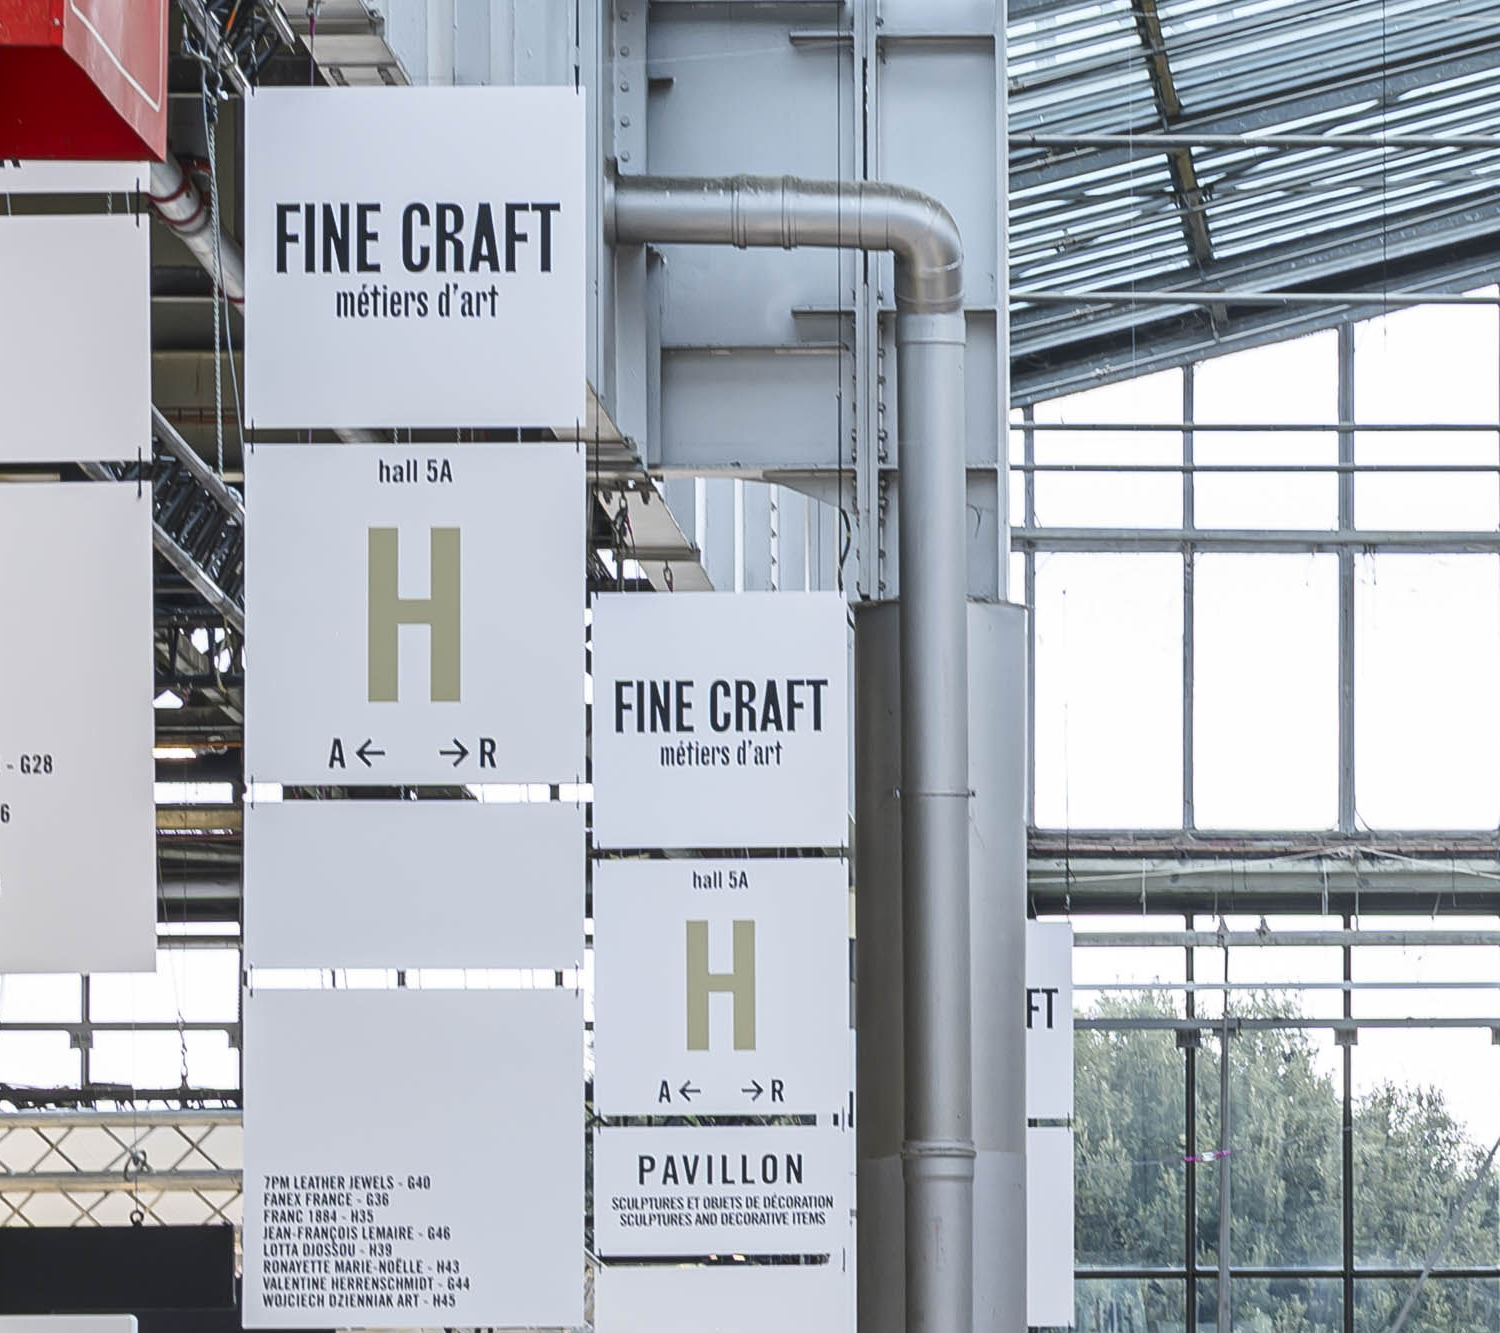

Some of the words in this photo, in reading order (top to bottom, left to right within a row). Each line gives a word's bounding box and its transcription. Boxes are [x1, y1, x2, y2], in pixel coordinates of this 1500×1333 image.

[276, 203, 381, 273] FINE
[402, 203, 560, 272] CRAFT
[337, 284, 428, 317] métiers
[439, 283, 498, 317] d'art
[379, 459, 417, 483] hall
[427, 459, 452, 482] 5A
[368, 527, 461, 703] H
[615, 680, 694, 733] FINE
[710, 679, 828, 732] CRAFT
[20, 755, 53, 774] G28
[329, 738, 345, 768] A
[480, 738, 496, 768] R
[661, 741, 729, 766] métiers
[737, 740, 782, 765] d'art
[693, 871, 722, 889] hall
[729, 871, 748, 888] 5A
[686, 920, 756, 1052] H
[659, 1080, 671, 1103] A
[772, 1080, 784, 1102] R
[639, 1154, 802, 1185] PAVILLON
[265, 1176, 289, 1189] 7PM
[294, 1176, 345, 1189] LEATHER
[350, 1176, 394, 1189] JEWELS
[408, 1176, 430, 1189] G40
[611, 1197, 685, 1210] SCULPTURES
[687, 1197, 699, 1210] ET
[703, 1196, 743, 1209] OBJETS
[745, 1196, 759, 1209] DE
[763, 1194, 834, 1209] DÉCORATION
[264, 1210, 303, 1223] FRANC
[309, 1210, 336, 1223] 1884
[351, 1210, 373, 1223] H35
[619, 1213, 693, 1226] SCULPTURES
[695, 1212, 718, 1225] AND
[720, 1212, 788, 1225] DECORATIVE
[792, 1212, 826, 1225] ITEMS
[264, 1226, 357, 1243] JEAN-FRANÇOIS
[362, 1226, 413, 1240] LEMAIRE
[428, 1227, 450, 1240] G46
[263, 1277, 326, 1290] VALENTINE
[332, 1277, 432, 1290] HERRENSCHMIDT
[448, 1277, 469, 1290] G44
